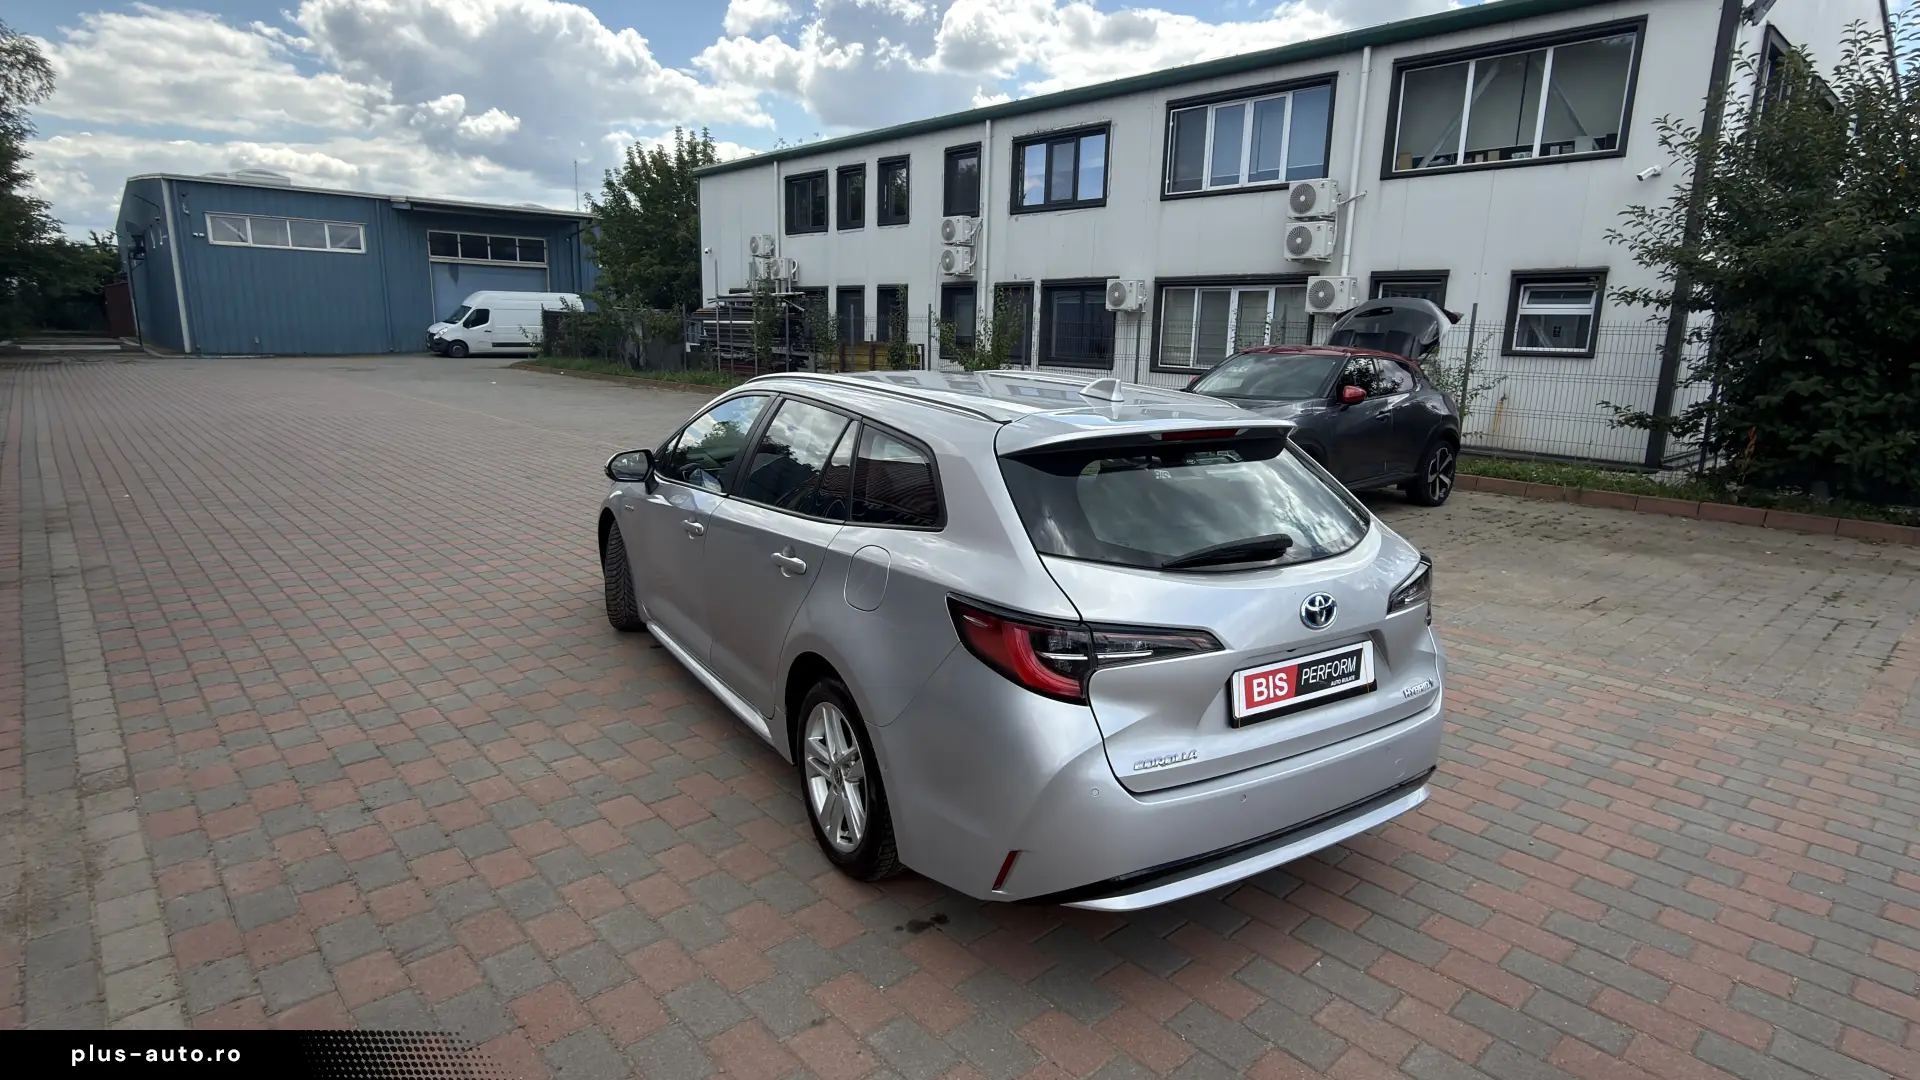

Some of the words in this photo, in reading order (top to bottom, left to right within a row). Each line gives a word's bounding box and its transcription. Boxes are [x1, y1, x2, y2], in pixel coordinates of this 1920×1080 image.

[1253, 673, 1289, 702] BIS
[1301, 656, 1356, 685] PERFORM
[1330, 679, 1342, 687] AUTO
[1402, 679, 1433, 698] HYBRID
[1133, 749, 1198, 771] COROLLA
